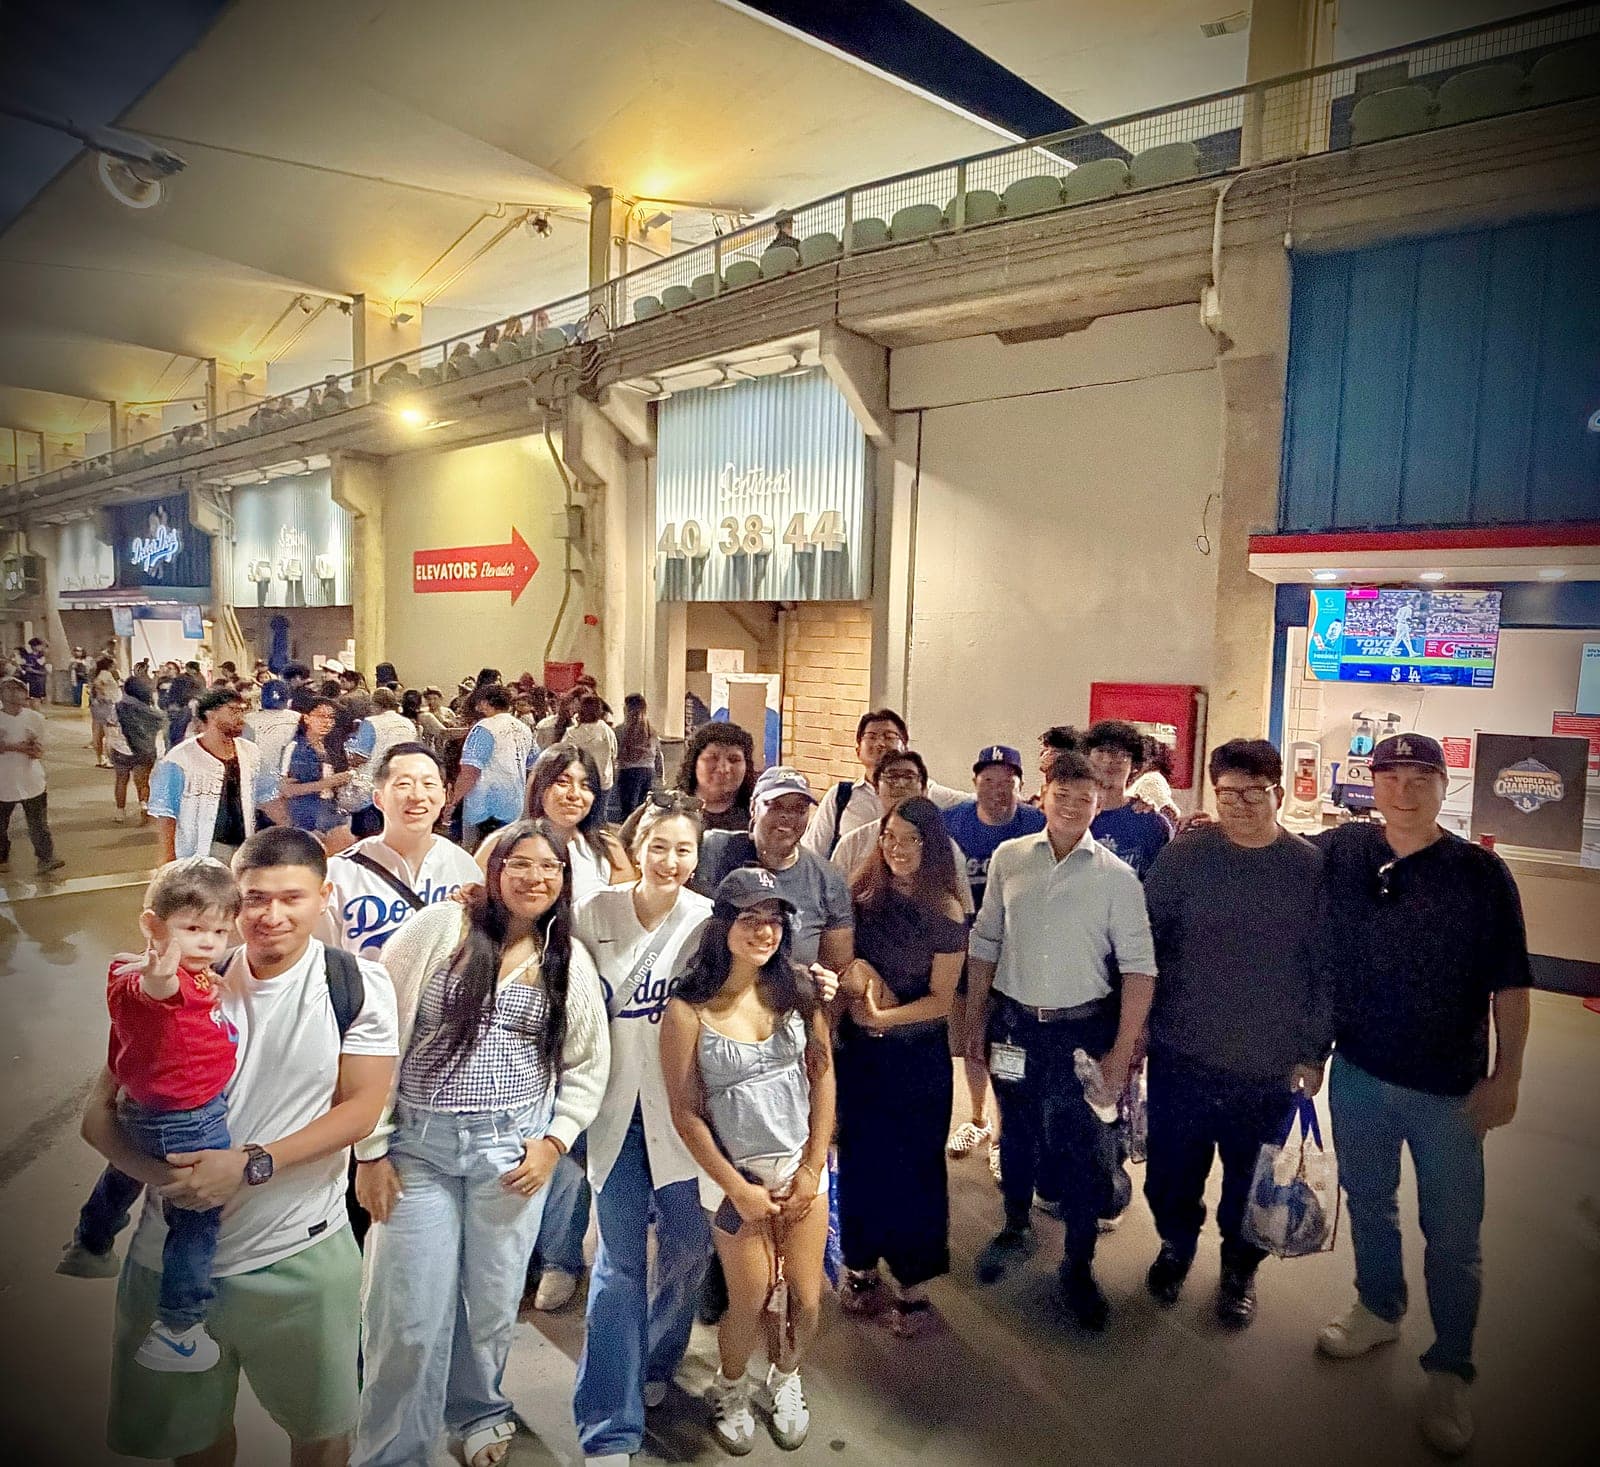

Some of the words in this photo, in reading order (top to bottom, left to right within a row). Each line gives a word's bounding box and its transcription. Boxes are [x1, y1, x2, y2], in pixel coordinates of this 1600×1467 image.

[657, 519, 703, 559] 40
[718, 514, 763, 556] 38
[782, 511, 842, 553] 44
[416, 562, 477, 580] ELEVATORS
[1395, 738, 1413, 756] LA
[1514, 776, 1545, 784] WORLD
[1496, 780, 1562, 799] CHAMPIONS
[756, 871, 775, 889] LA
